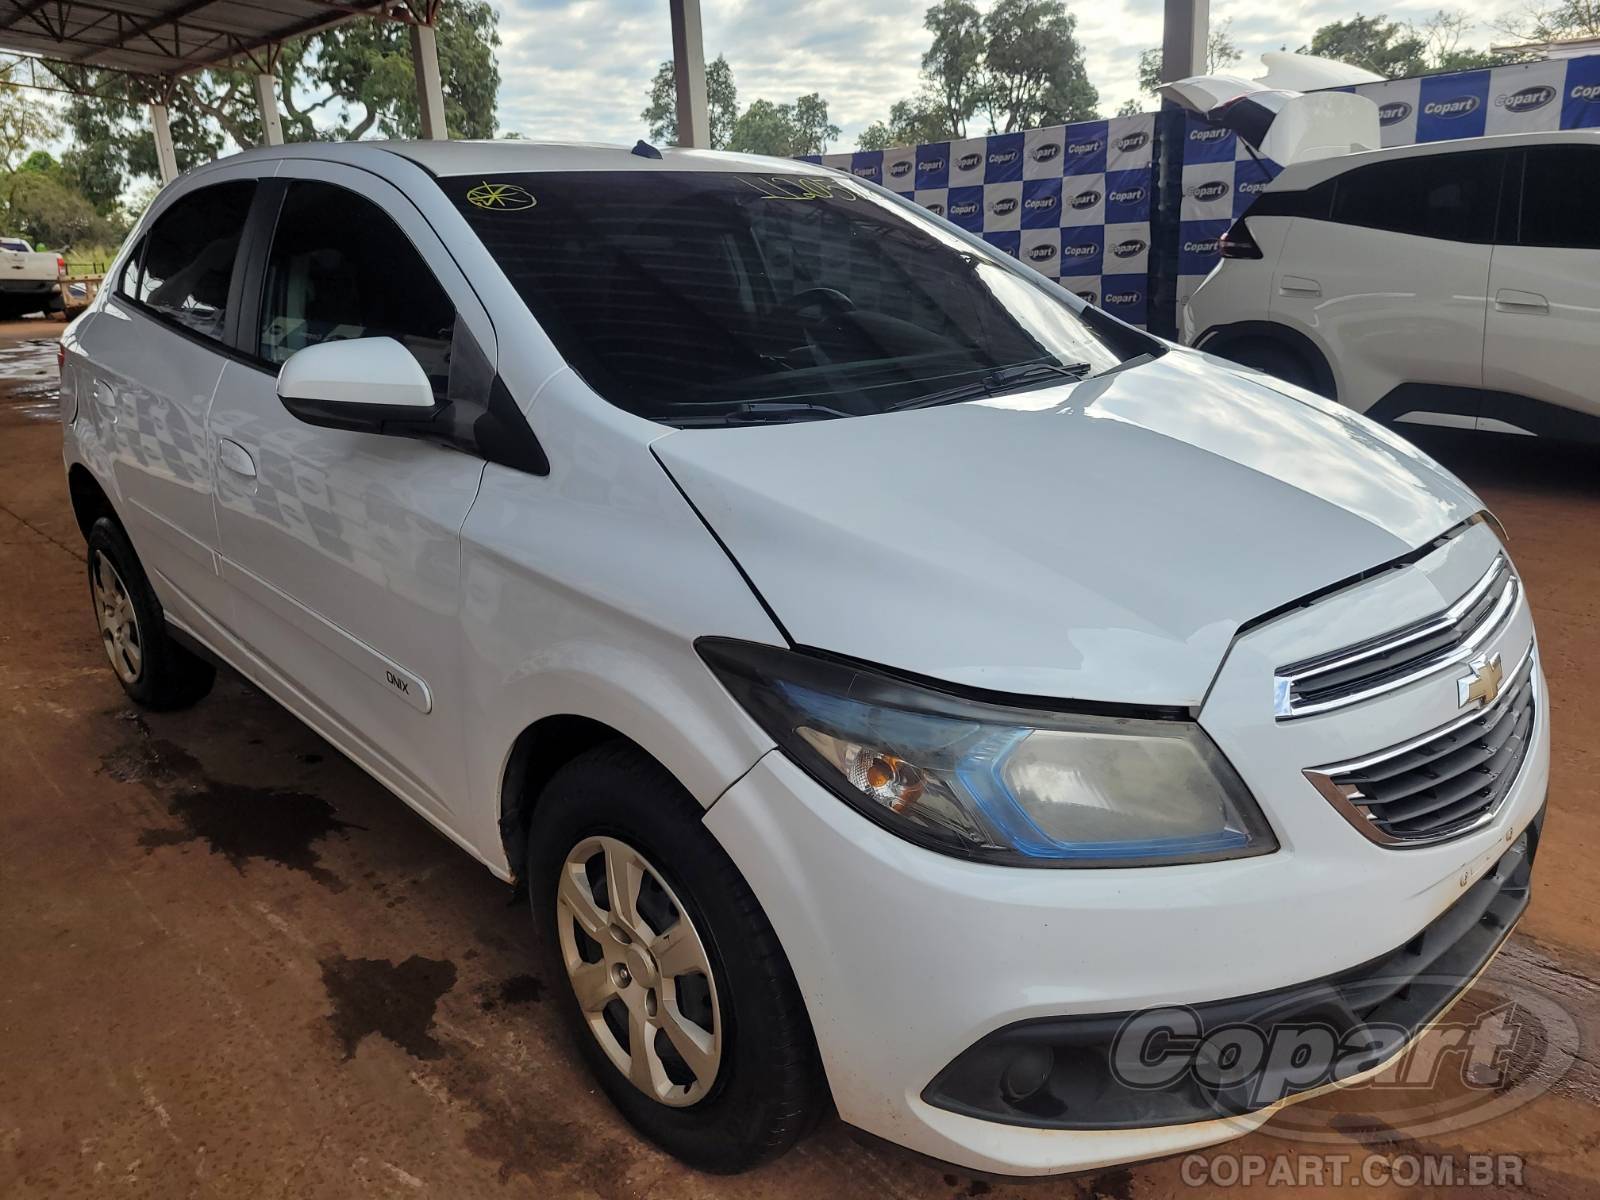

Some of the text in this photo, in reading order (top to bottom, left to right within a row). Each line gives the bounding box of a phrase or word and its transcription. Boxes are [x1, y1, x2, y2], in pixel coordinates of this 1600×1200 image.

[1495, 91, 1548, 107] Copart
[1570, 86, 1600, 99] Cop
[1379, 106, 1404, 119] art
[1424, 100, 1473, 117] Copart
[1190, 128, 1226, 142] Copart
[1068, 142, 1100, 155] Copart
[988, 151, 1017, 165] Copart
[918, 159, 943, 172] Copart
[1109, 188, 1142, 203] Copart
[1239, 183, 1266, 195] Copa
[1024, 195, 1053, 208] Copart
[950, 204, 976, 215] Copart
[1064, 244, 1095, 257] Copart
[1184, 242, 1218, 253] Copart
[1105, 292, 1138, 304] Copart
[386, 670, 409, 695] ONIX
